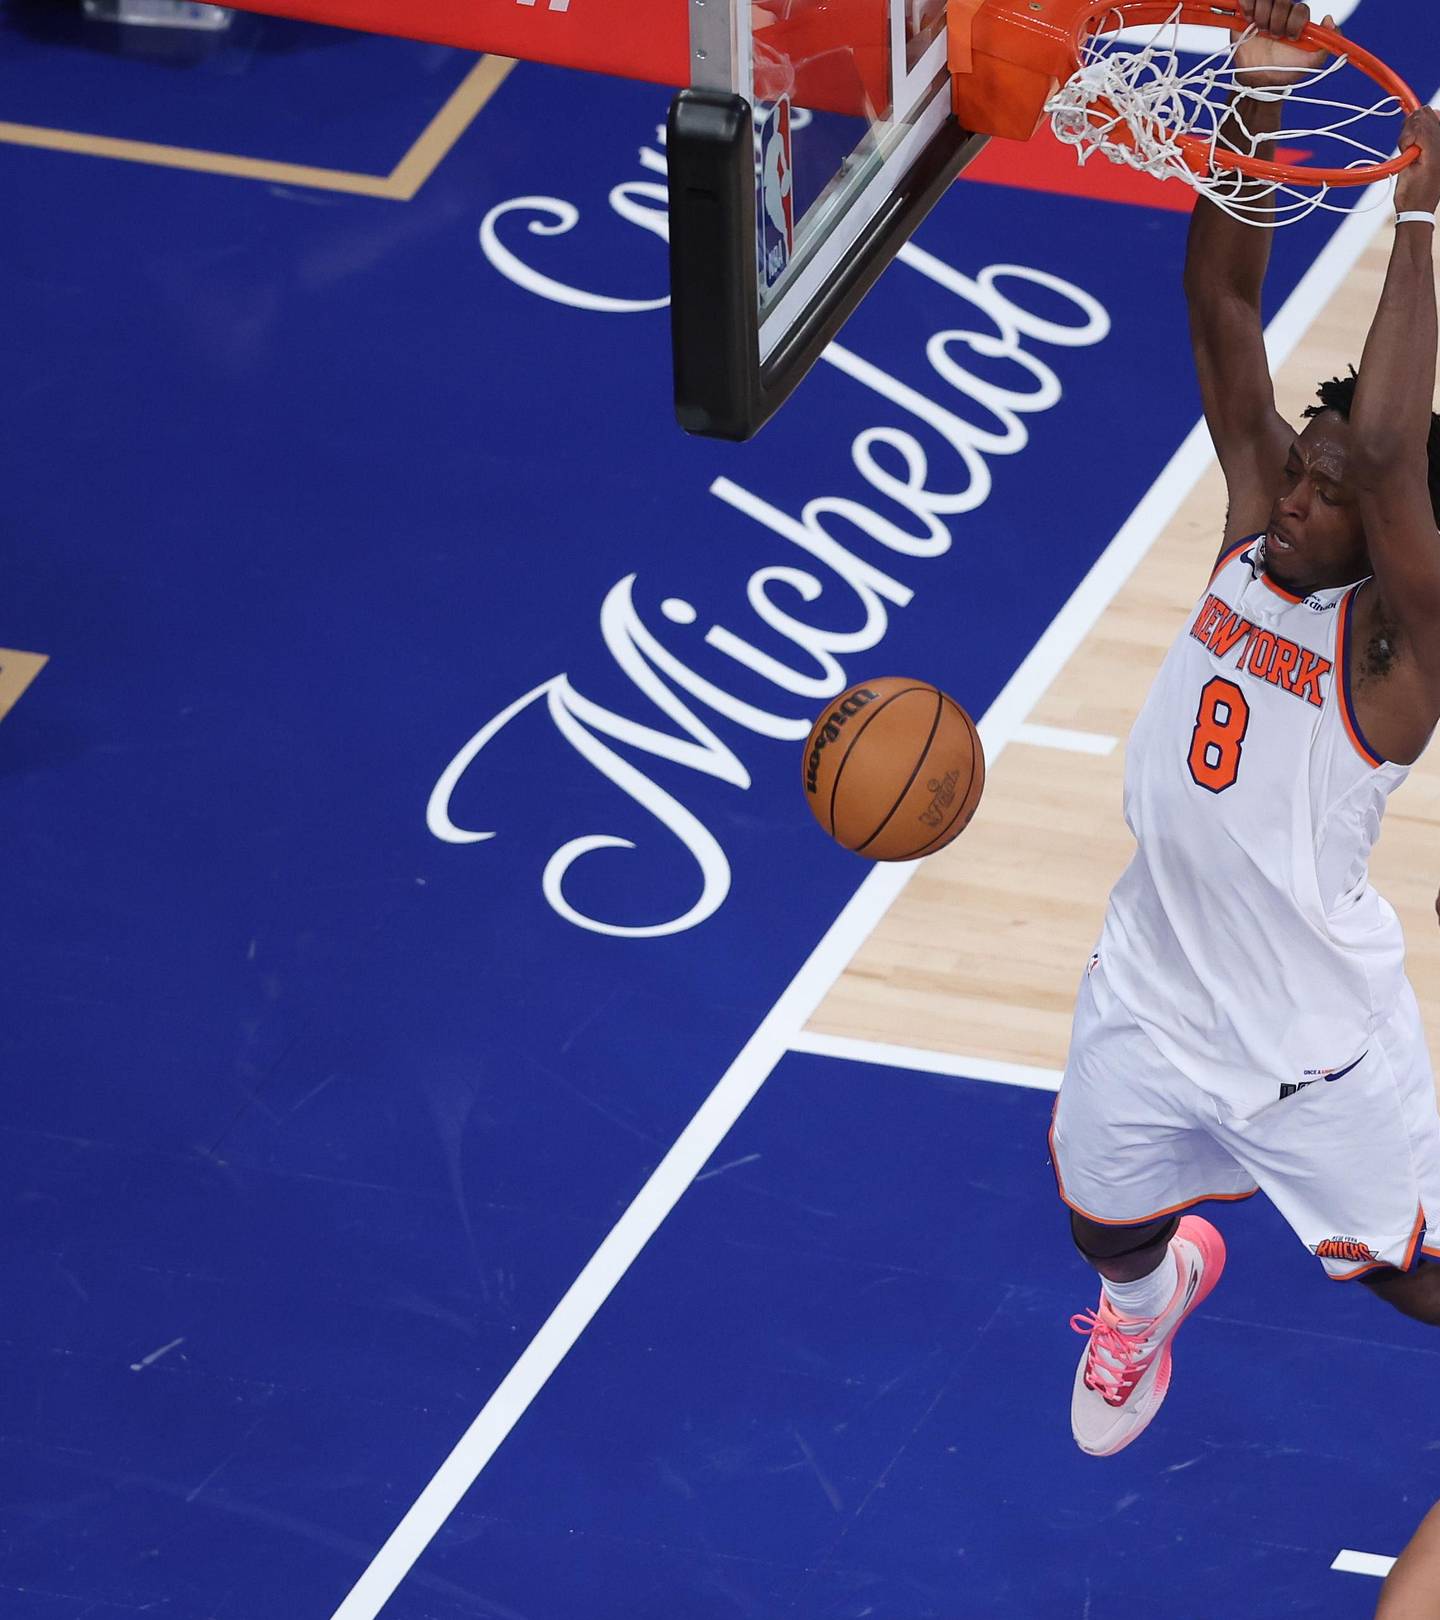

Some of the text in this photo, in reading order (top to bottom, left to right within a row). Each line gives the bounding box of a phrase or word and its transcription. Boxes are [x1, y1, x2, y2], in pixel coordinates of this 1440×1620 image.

[426, 241, 1111, 938] Michelob
[1189, 593, 1333, 708] NEW YORK
[806, 688, 881, 794] Wilson
[1187, 674, 1250, 794] 8
[1316, 1239, 1374, 1261] KNICKS
